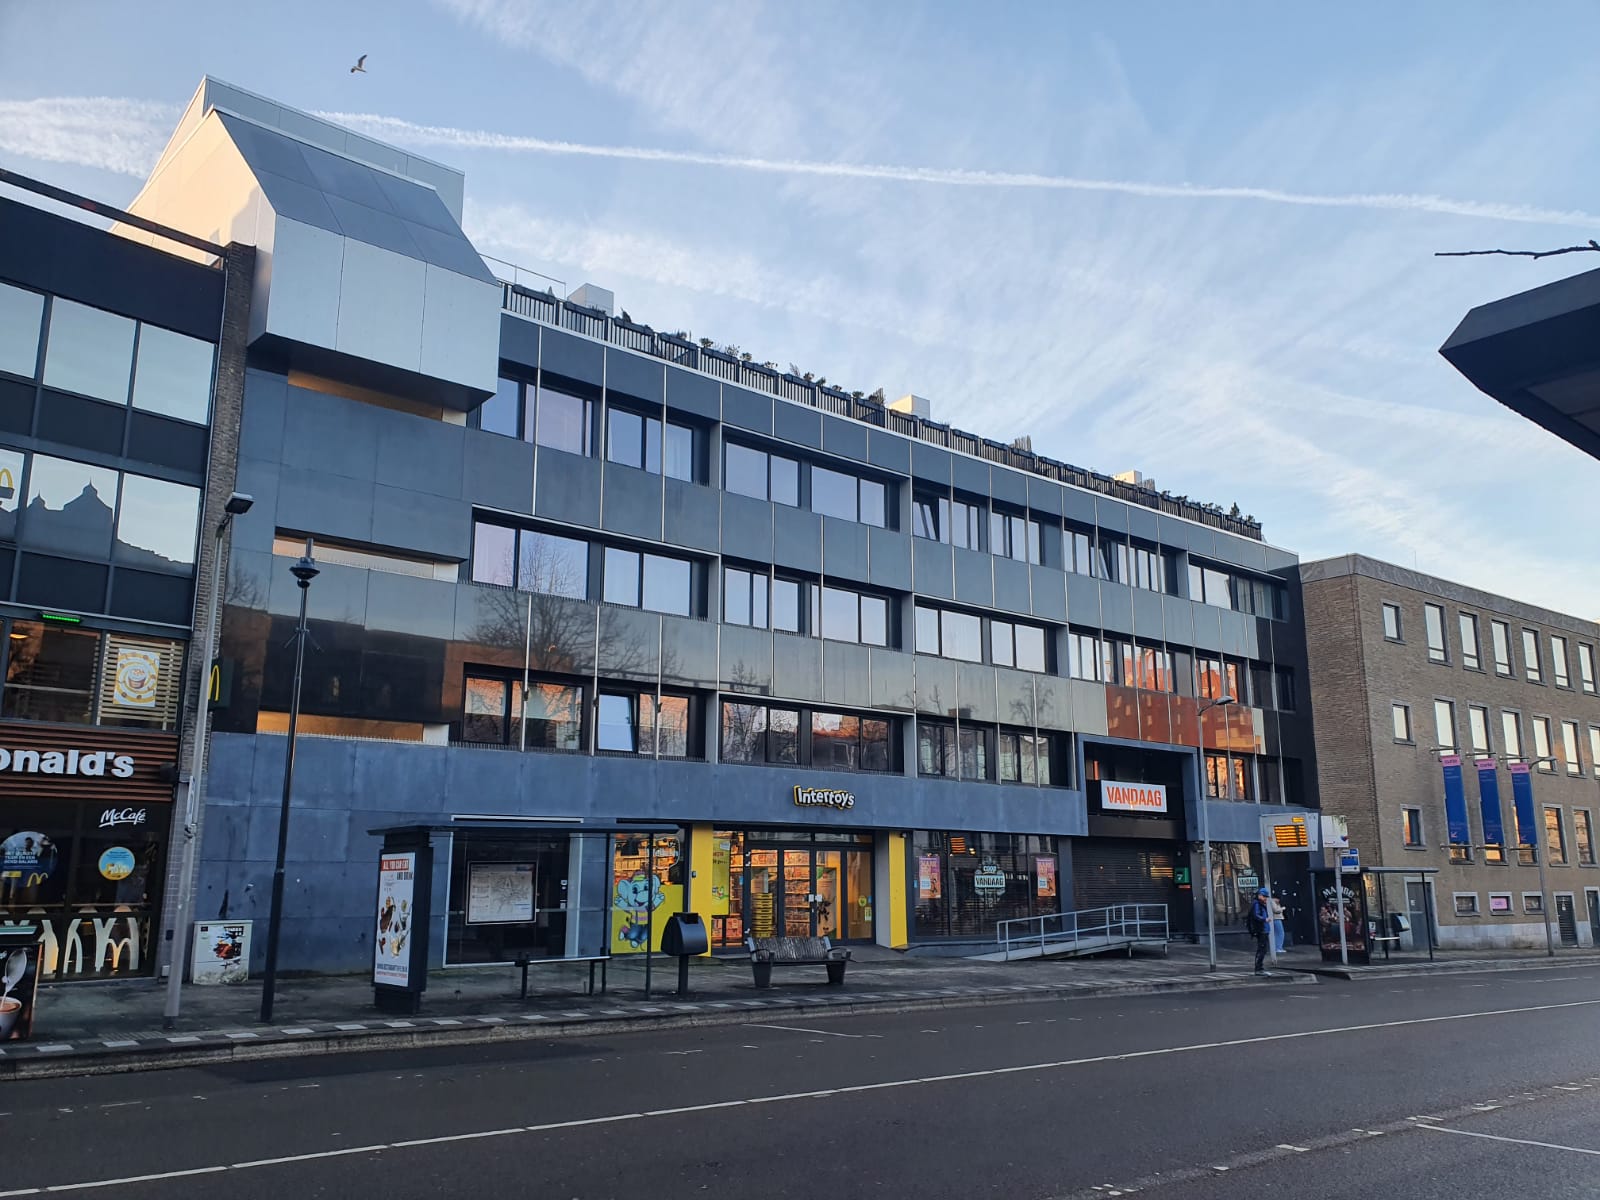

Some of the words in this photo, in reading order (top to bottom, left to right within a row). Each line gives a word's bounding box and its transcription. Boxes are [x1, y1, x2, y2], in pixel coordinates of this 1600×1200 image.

[796, 786, 855, 808] Intertoys
[1106, 786, 1162, 807] VANDAAG
[99, 807, 147, 827] McCafé
[976, 877, 1004, 886] VANDAAG
